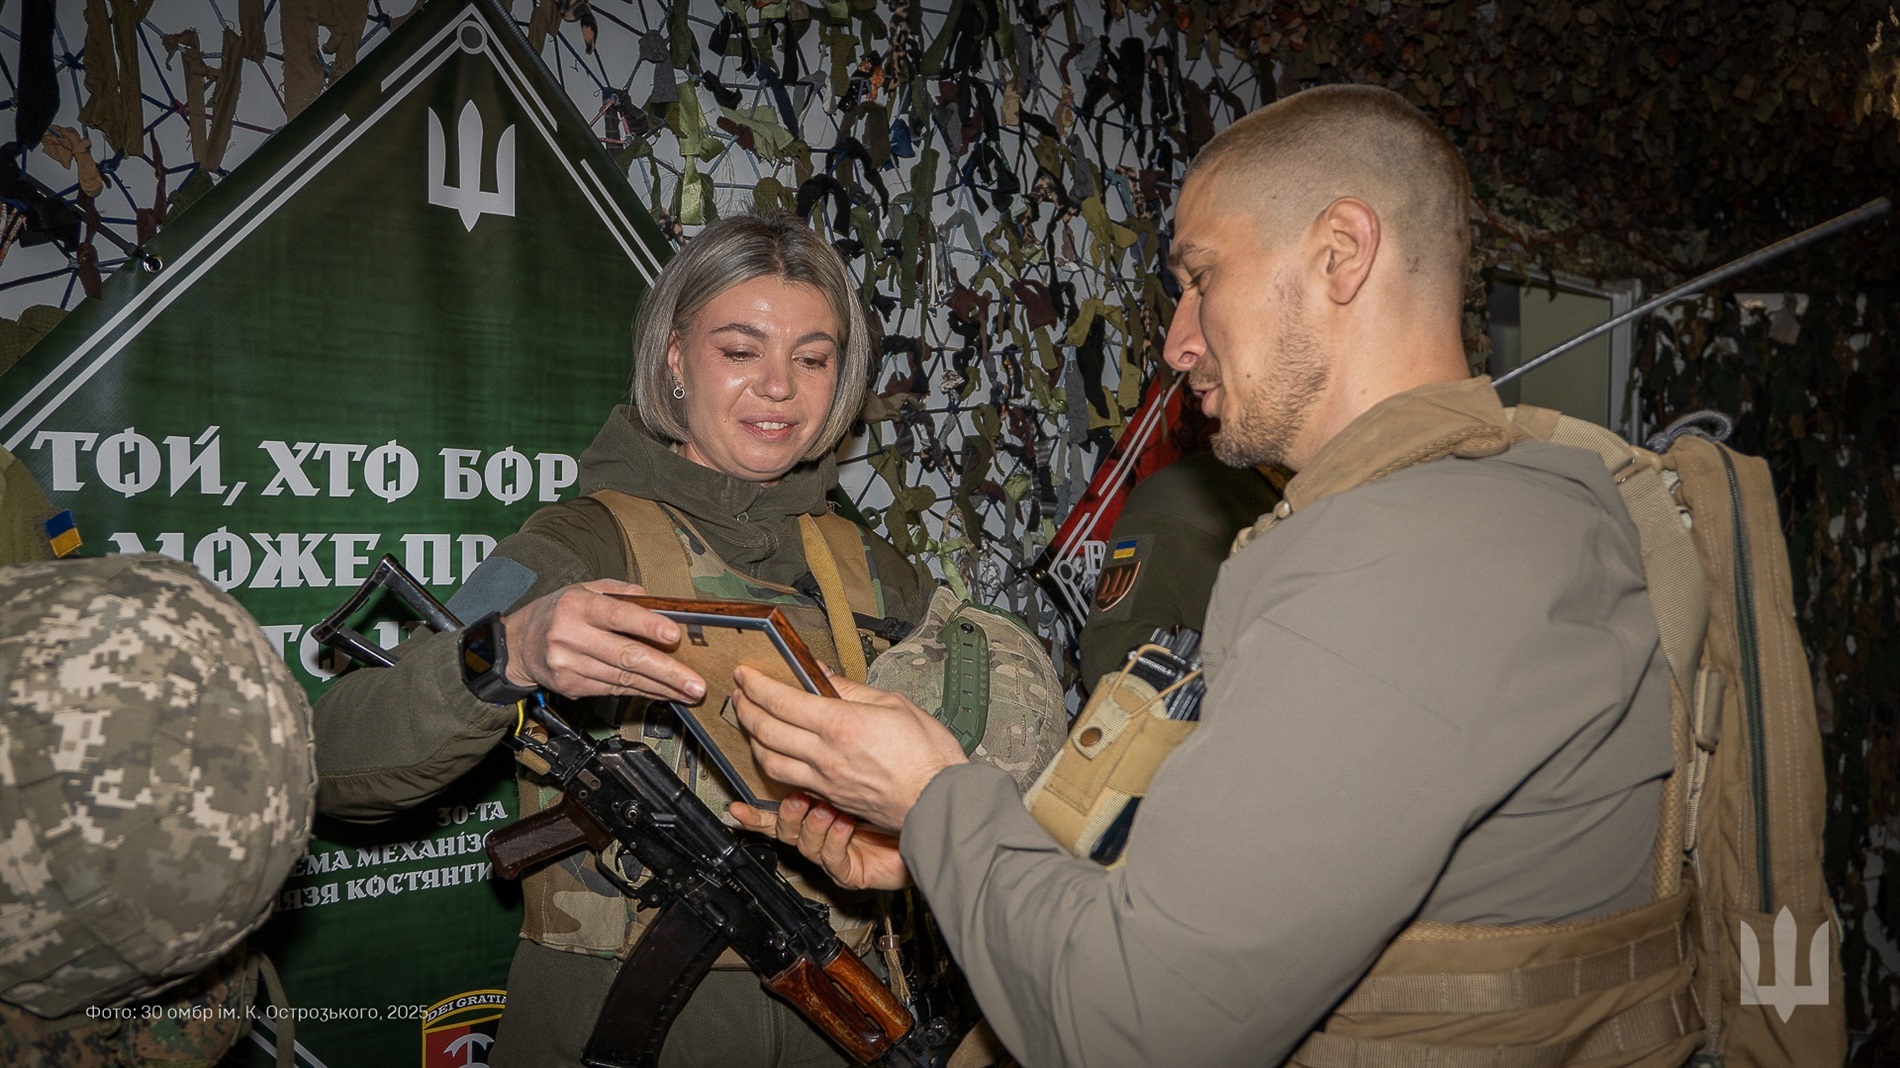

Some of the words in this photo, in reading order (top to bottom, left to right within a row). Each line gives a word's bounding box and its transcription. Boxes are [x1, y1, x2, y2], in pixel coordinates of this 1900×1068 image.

[30, 426, 247, 506] ТОЙ,
[258, 439, 419, 503] ХТО
[438, 445, 579, 505] БОР
[436, 800, 509, 828] 30-ТА
[426, 1001, 455, 1023] DEI
